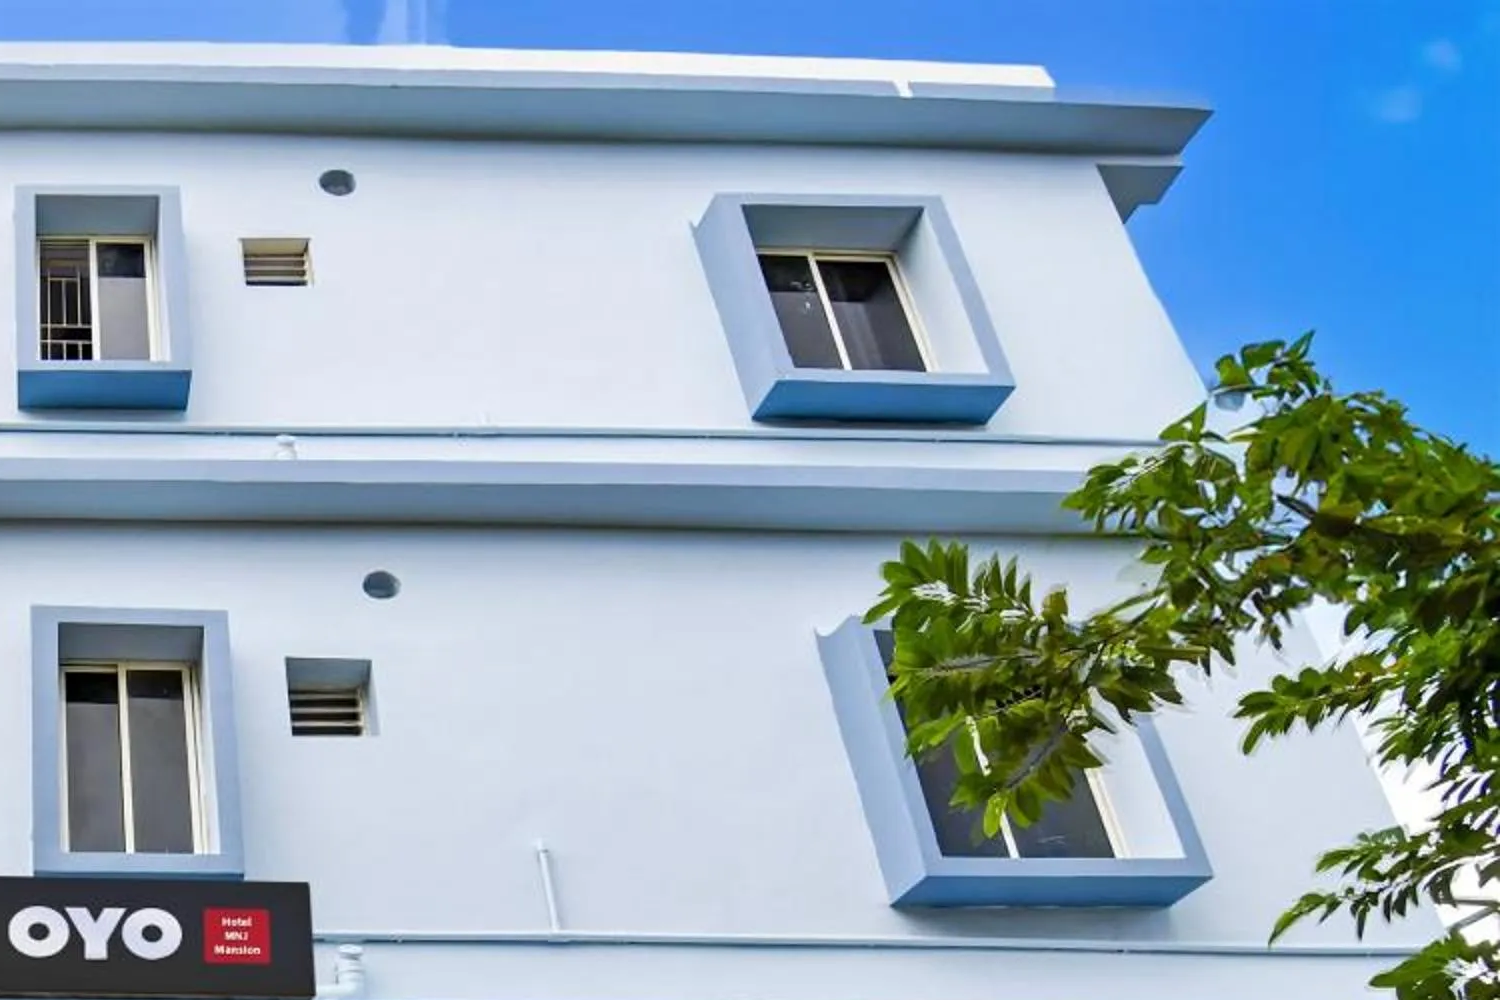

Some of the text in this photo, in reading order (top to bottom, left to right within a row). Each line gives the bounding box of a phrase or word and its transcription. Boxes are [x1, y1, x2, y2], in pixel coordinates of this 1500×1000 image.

[221, 916, 253, 927] Hotel
[7, 906, 183, 960] OYO
[213, 944, 261, 955] Mansion
